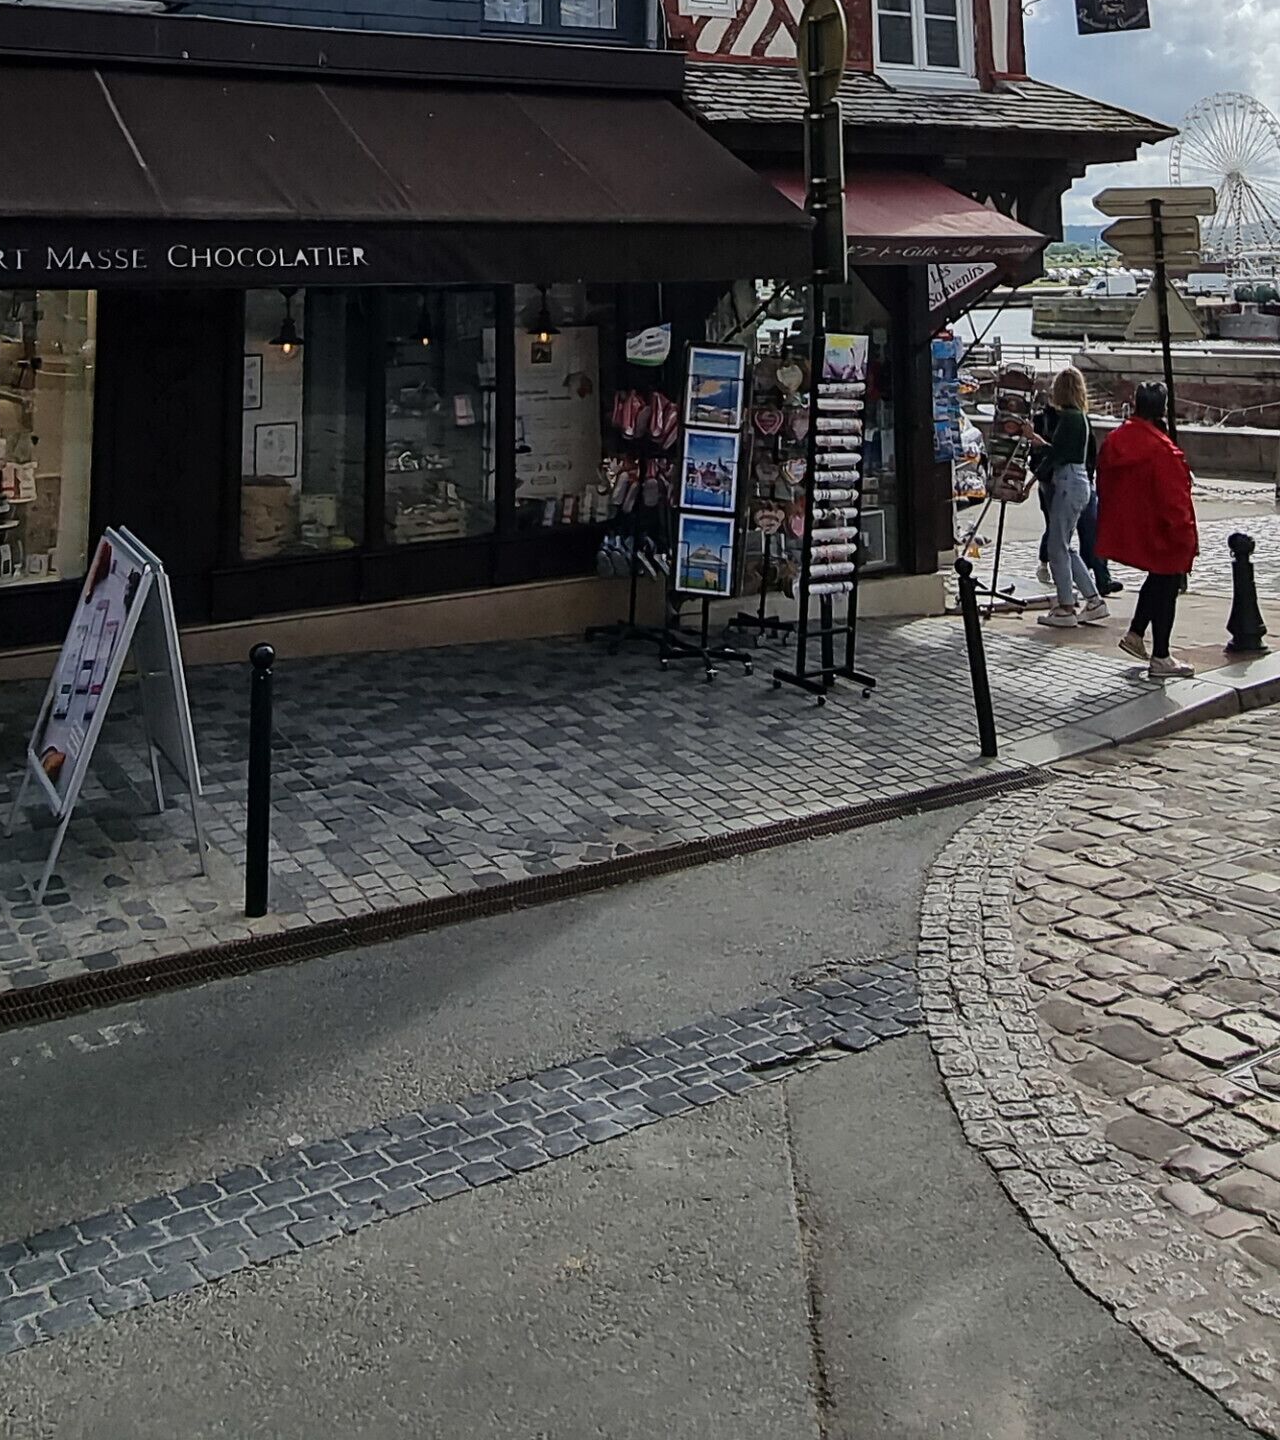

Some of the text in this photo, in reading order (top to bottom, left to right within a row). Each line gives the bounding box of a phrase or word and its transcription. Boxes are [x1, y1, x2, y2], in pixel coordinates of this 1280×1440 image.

[46, 245, 148, 270] MASSE
[167, 244, 370, 269] CHOCOLATIER
[928, 266, 985, 308] Souvenirs
